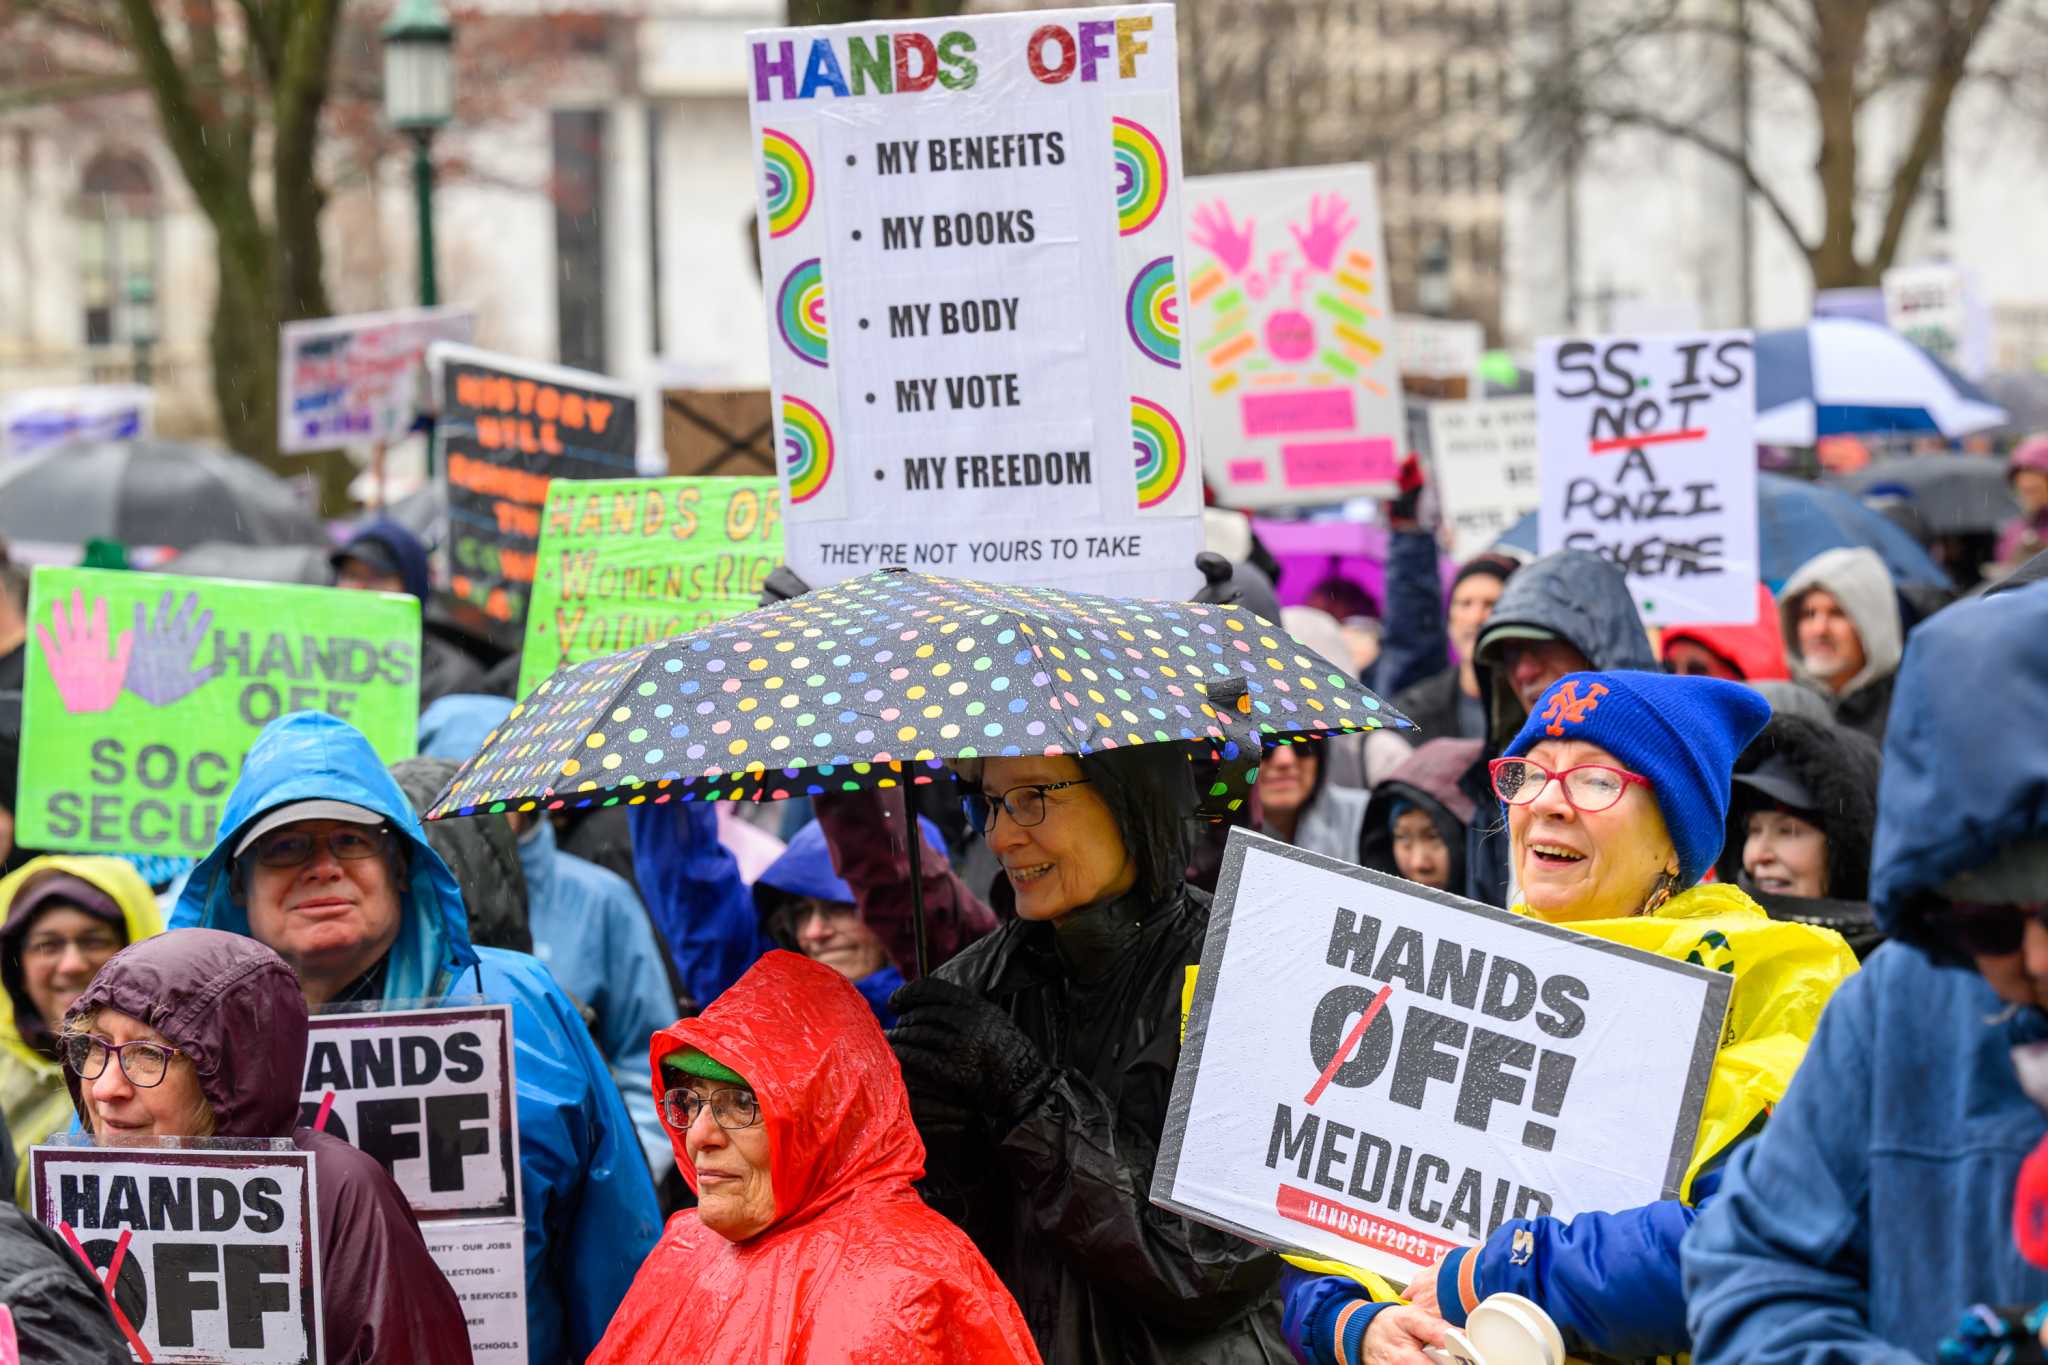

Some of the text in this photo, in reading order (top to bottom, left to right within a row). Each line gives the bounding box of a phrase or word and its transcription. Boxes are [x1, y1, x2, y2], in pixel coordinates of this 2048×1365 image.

[753, 15, 1153, 102] HANDS OFF
[876, 131, 1066, 175] MY BENEFITS
[881, 209, 1035, 250] MY BOOKS
[888, 297, 1020, 338] MY BODY
[1669, 341, 1751, 389] IS
[895, 373, 1020, 413] MY VOTE
[1590, 392, 1711, 440] NOT
[904, 451, 1092, 490] MY FREEDOM
[1616, 447, 1655, 484] A
[547, 486, 700, 540] HANDS
[1564, 478, 1722, 520] PONZI
[820, 535, 1141, 564] THEY'RE NOT YOURS TO TAKE
[715, 554, 784, 601] RIG
[213, 630, 414, 686] HANDS
[46, 791, 224, 850] SECU
[1325, 906, 1590, 1040] HANDS
[305, 1031, 484, 1092] ANDS
[1308, 984, 1577, 1152] OFF!
[60, 1173, 286, 1234] HANDS
[429, 1242, 512, 1252] RITY OUR JOBS
[78, 1238, 291, 1350] OFF
[470, 1291, 518, 1300] SERVICES
[472, 1341, 519, 1351] SCHOOLS
